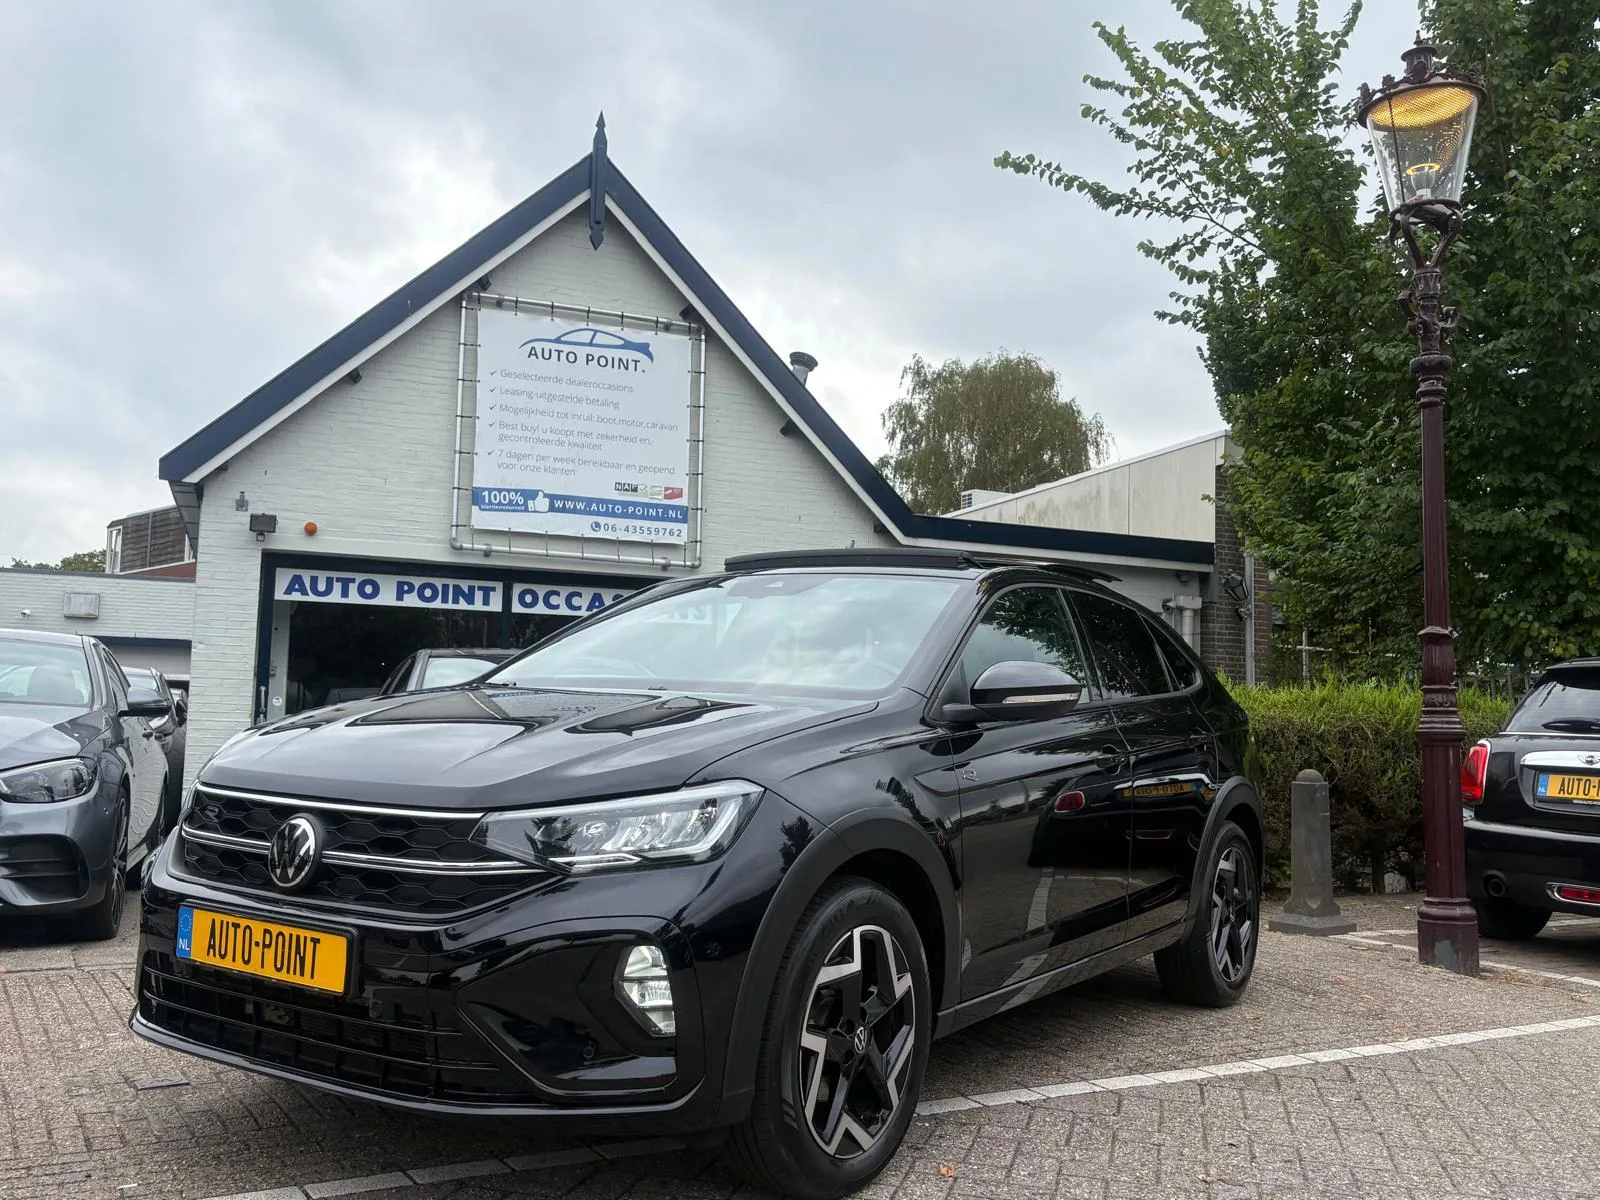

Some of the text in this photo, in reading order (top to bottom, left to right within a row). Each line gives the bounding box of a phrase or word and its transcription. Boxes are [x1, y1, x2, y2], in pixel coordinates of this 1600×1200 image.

[527, 346, 577, 364] AUTO
[500, 369, 634, 393] Geselecteerde dealeroccasions
[499, 404, 555, 418] Mogelijkheid
[556, 411, 569, 419] tot
[585, 396, 620, 410] betaling
[497, 433, 566, 447] gecontroleerde
[499, 421, 518, 430] Best
[549, 426, 575, 438] koopt
[576, 430, 594, 439] met
[595, 432, 638, 444] zekerheid
[496, 461, 576, 477] voor onze klanten
[505, 450, 534, 462] dagen
[535, 454, 551, 463] per
[552, 456, 577, 465] week
[577, 458, 623, 470] bereikbaar
[625, 463, 637, 471] en
[638, 464, 676, 476] geopend
[481, 490, 525, 505] 100%
[553, 498, 684, 519] WWW.AUTO-POINT.NL
[602, 522, 683, 538] 06-43559762
[282, 574, 497, 607] AUTO POINT
[179, 918, 321, 980] NL AUTO-POINT
